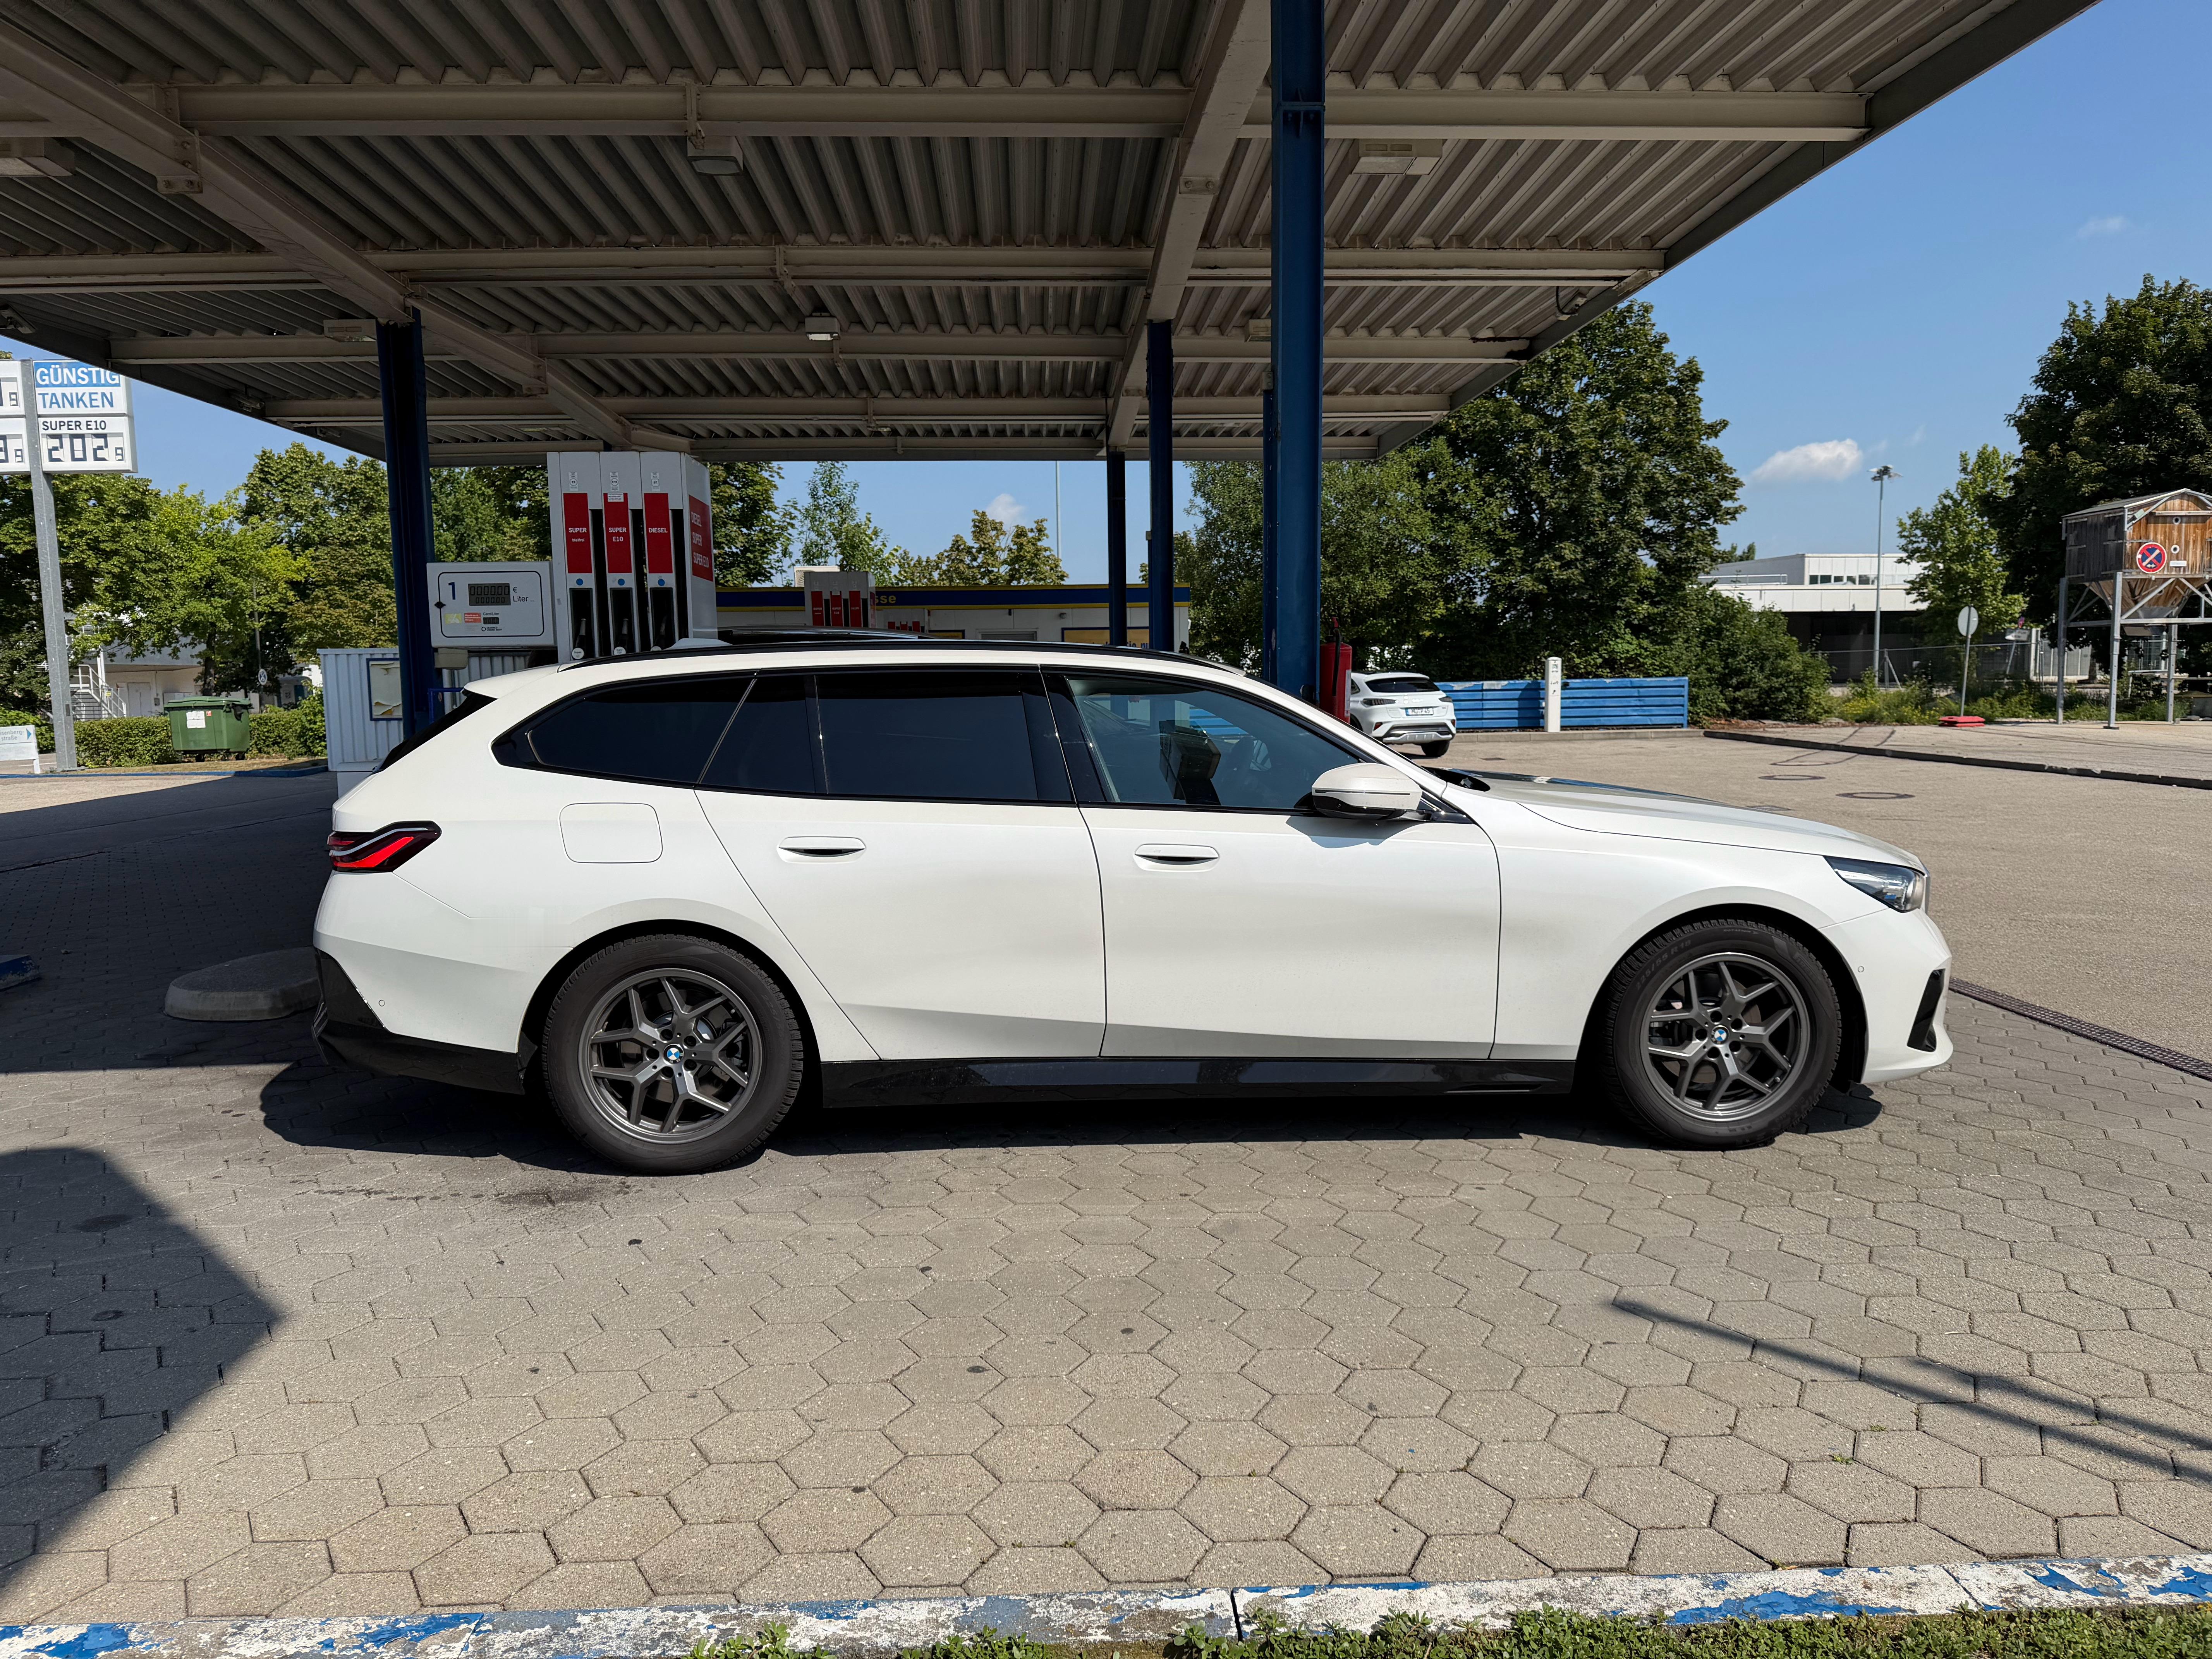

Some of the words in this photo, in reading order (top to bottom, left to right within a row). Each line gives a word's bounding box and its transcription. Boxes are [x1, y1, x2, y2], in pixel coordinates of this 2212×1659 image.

[36, 365, 120, 385] GÜNSTIG
[38, 392, 114, 409] TANKEN
[42, 421, 82, 431] SUPER
[86, 420, 106, 430] E10
[448, 582, 456, 600] 1
